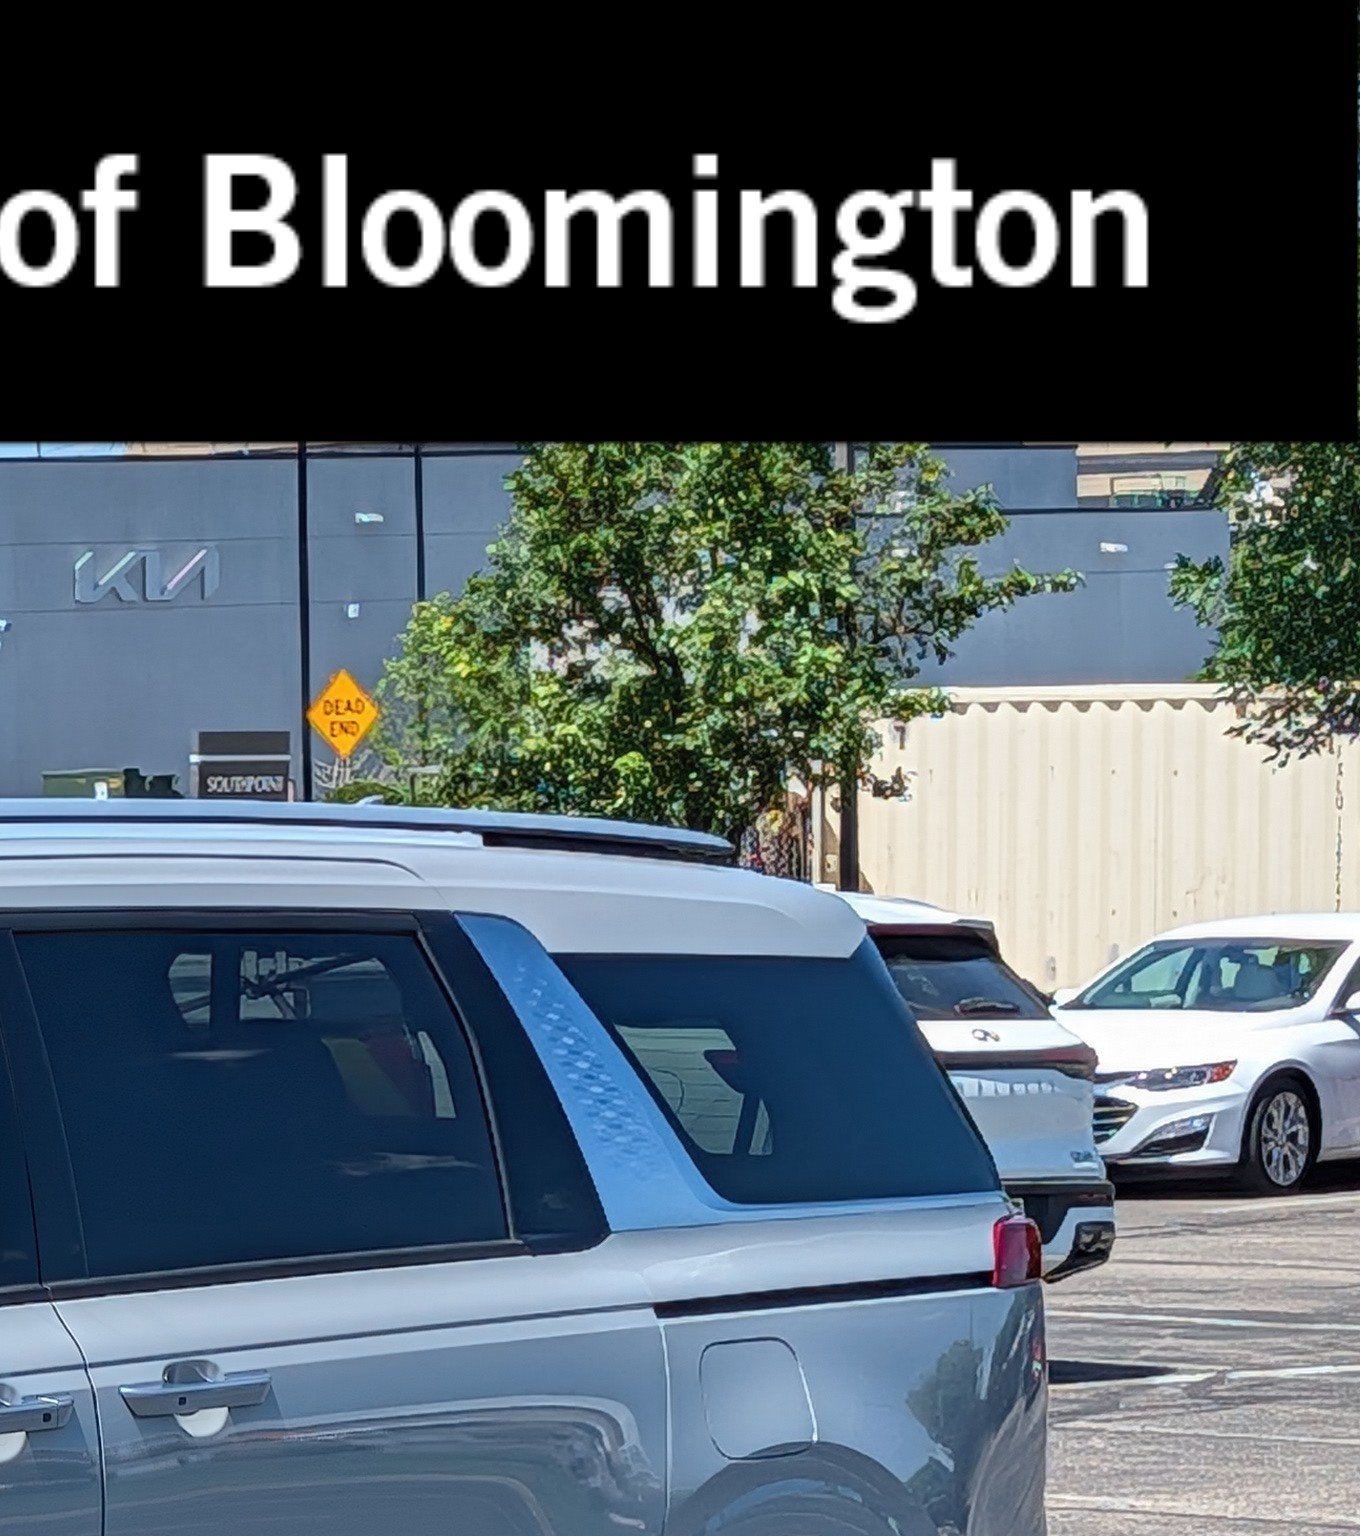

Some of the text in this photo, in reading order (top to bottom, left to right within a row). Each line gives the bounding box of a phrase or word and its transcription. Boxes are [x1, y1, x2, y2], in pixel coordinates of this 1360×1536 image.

[74, 548, 221, 603] KIA
[322, 698, 366, 716] DEAD
[329, 720, 360, 738] END
